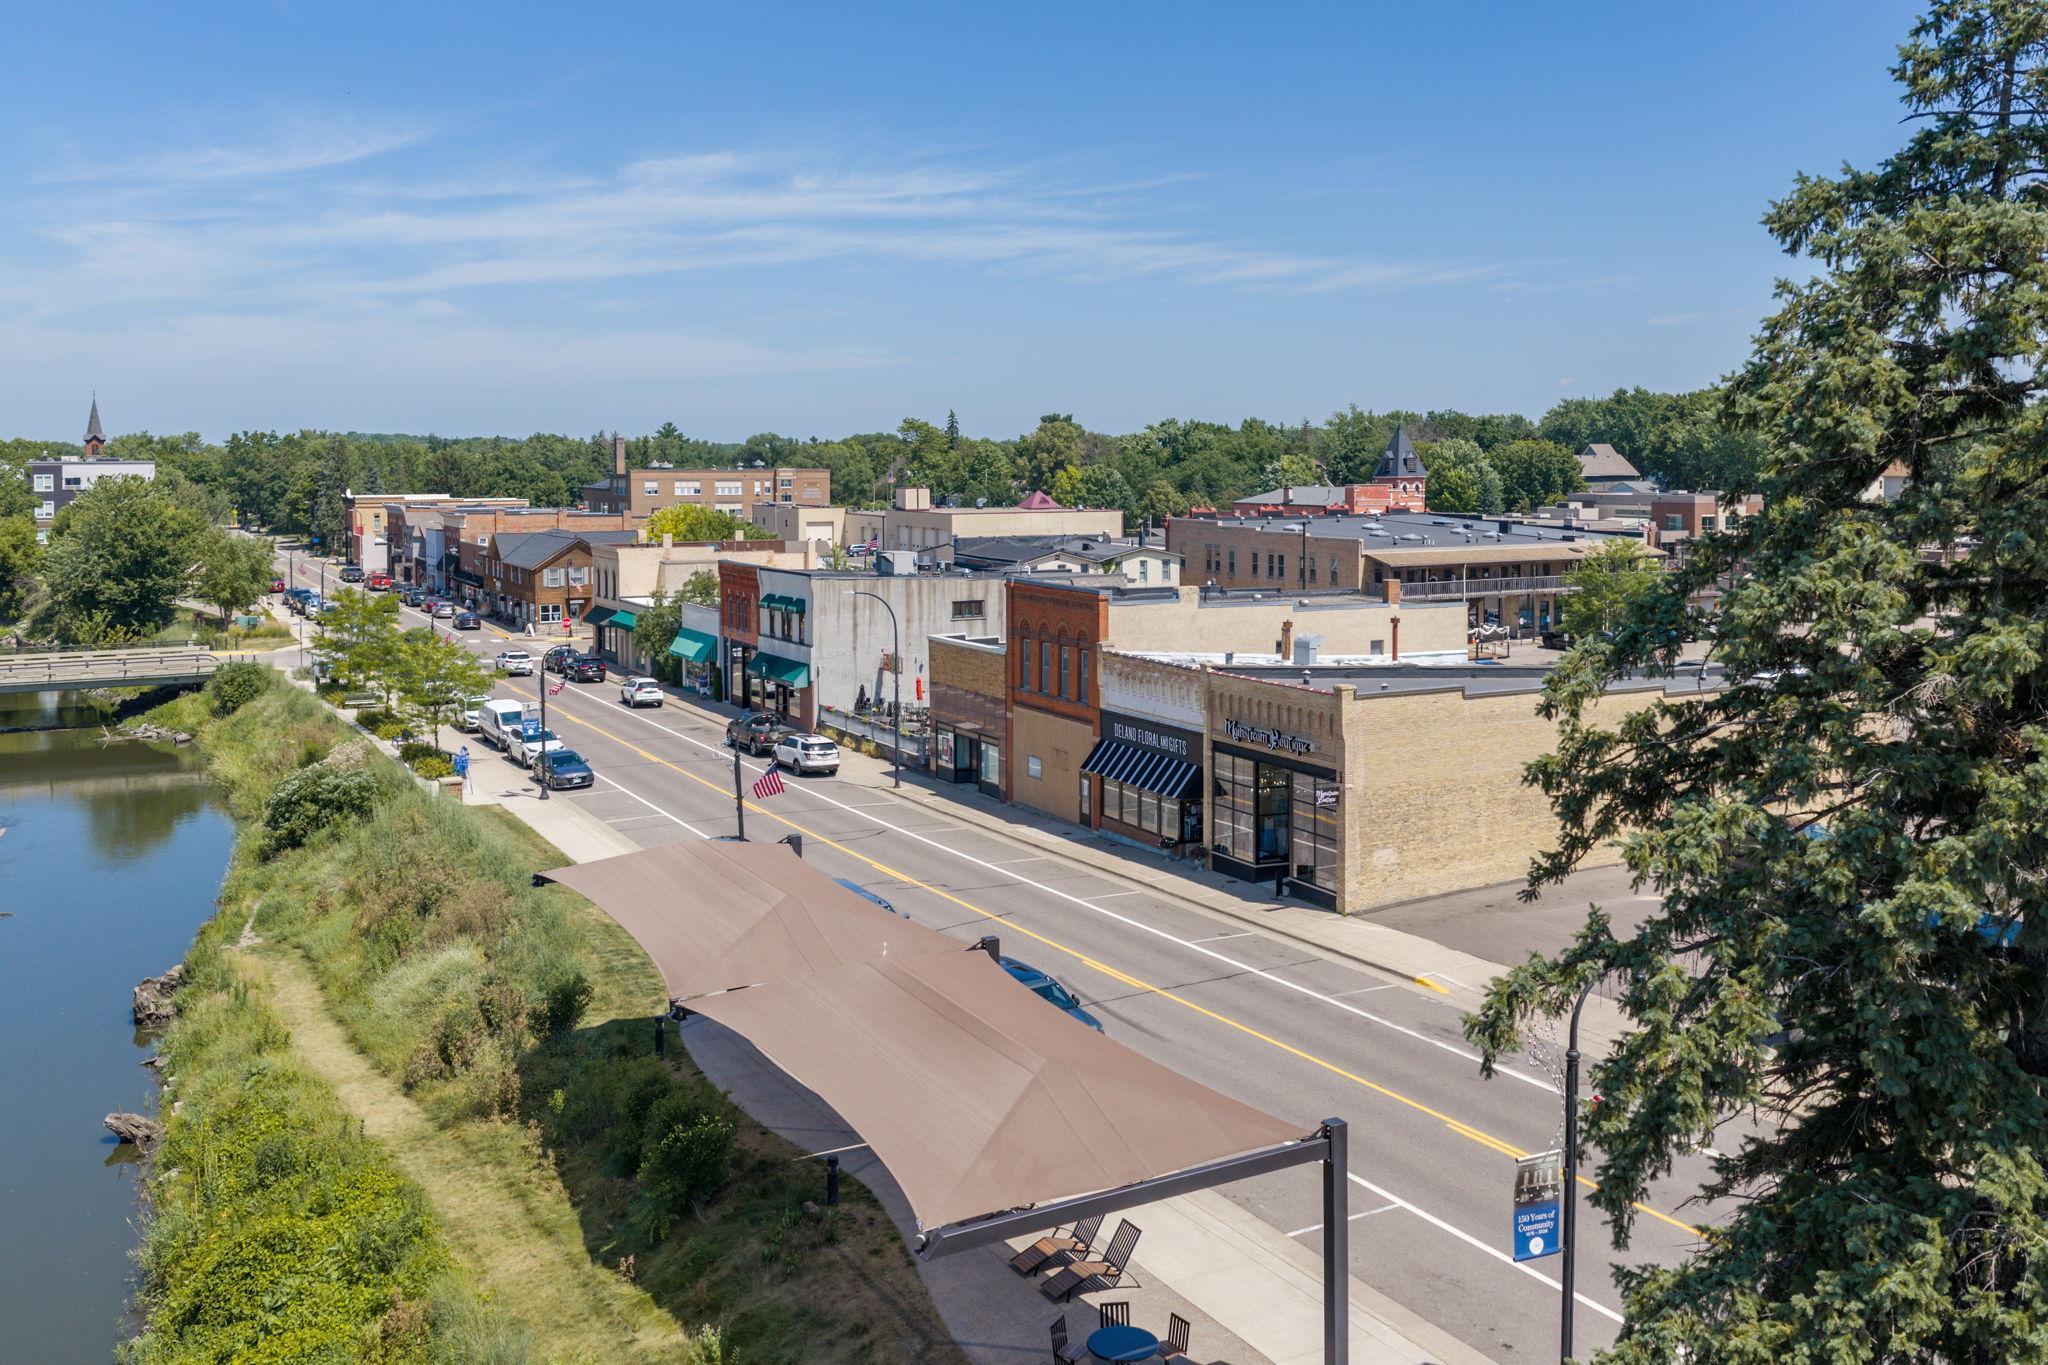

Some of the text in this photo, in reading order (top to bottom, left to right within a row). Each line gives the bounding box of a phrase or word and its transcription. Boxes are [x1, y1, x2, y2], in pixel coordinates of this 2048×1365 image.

[1114, 722, 1137, 742] DELANO
[1138, 729, 1160, 749] FLORAL
[1168, 737, 1187, 755] GIFTS
[1266, 728, 1311, 756] Boutique
[1518, 1210, 1555, 1224] 150 Years of
[1518, 1220, 1555, 1233] Community
